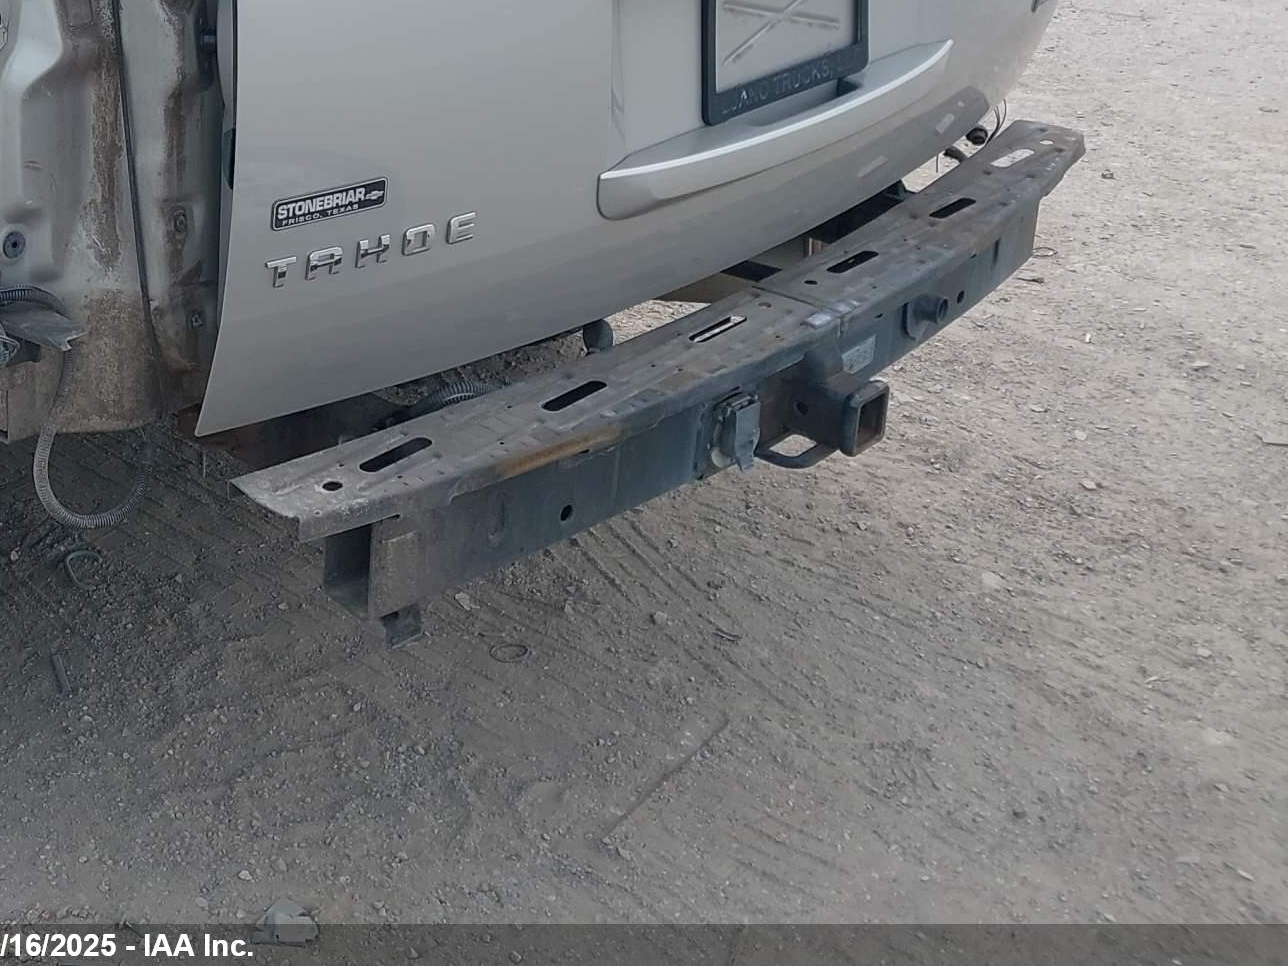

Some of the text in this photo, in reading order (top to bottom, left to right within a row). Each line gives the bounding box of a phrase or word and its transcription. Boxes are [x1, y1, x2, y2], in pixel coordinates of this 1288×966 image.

[277, 187, 366, 220] STONEBRIAR
[327, 203, 359, 216] TEXAS
[265, 211, 478, 288] TAHOE
